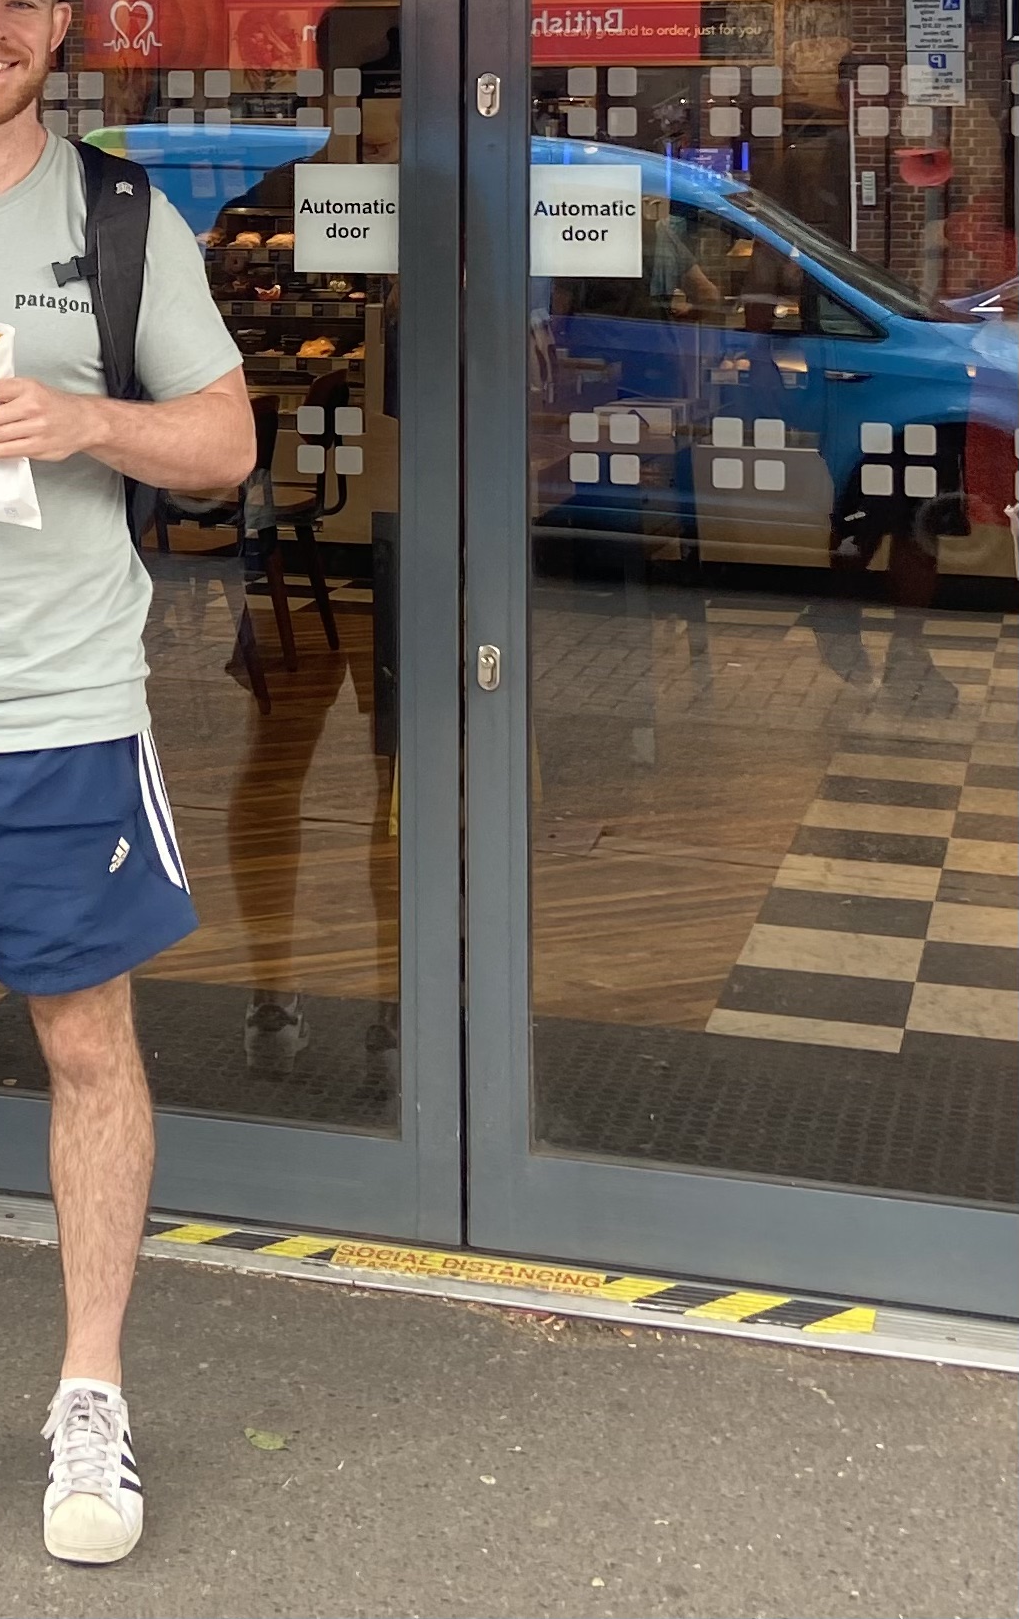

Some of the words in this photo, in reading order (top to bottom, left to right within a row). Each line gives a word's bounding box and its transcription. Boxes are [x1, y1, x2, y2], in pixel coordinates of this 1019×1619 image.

[641, 26, 654, 37] to
[657, 24, 690, 38] order,
[694, 24, 715, 39] just
[719, 24, 736, 36] for
[738, 27, 762, 38] you
[299, 198, 396, 215] Automatic
[534, 200, 636, 217] Automatic
[326, 223, 370, 239] door
[562, 226, 608, 242] door
[338, 1243, 435, 1267] SOCIAL
[441, 1257, 601, 1289] DISTANCING
